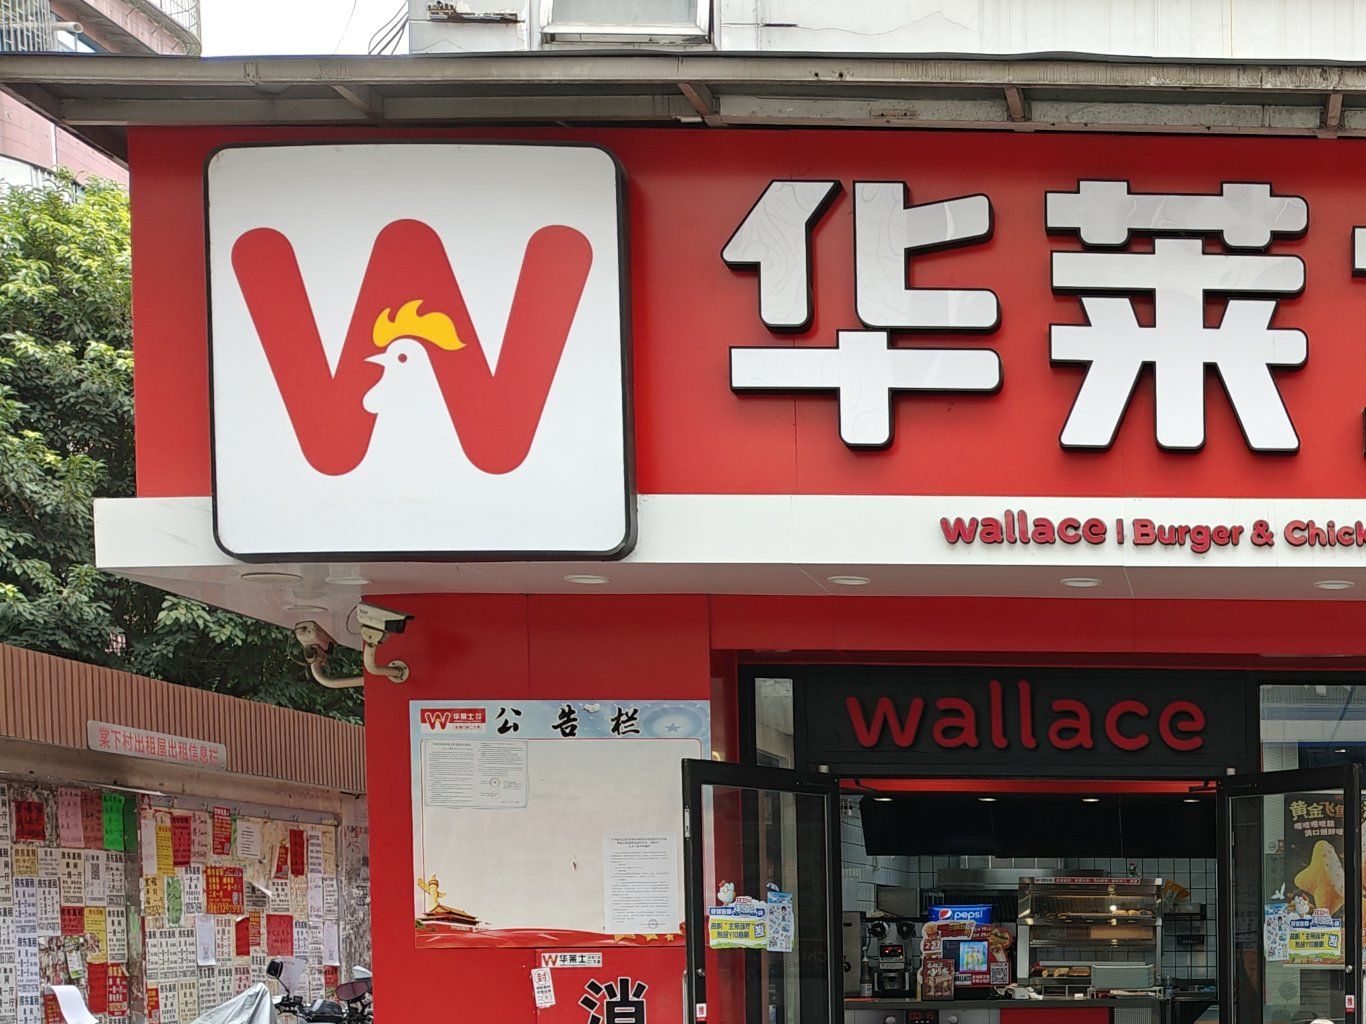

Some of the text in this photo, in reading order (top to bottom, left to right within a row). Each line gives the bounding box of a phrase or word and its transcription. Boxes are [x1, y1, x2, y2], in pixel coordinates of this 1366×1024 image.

[939, 509, 1108, 545] wallace
[1132, 518, 1245, 554] Burger
[1251, 519, 1275, 547] &
[496, 704, 641, 737] 公告栏
[846, 679, 1205, 750] wallace
[954, 910, 983, 921] pepsi
[560, 954, 587, 964] 华莱士
